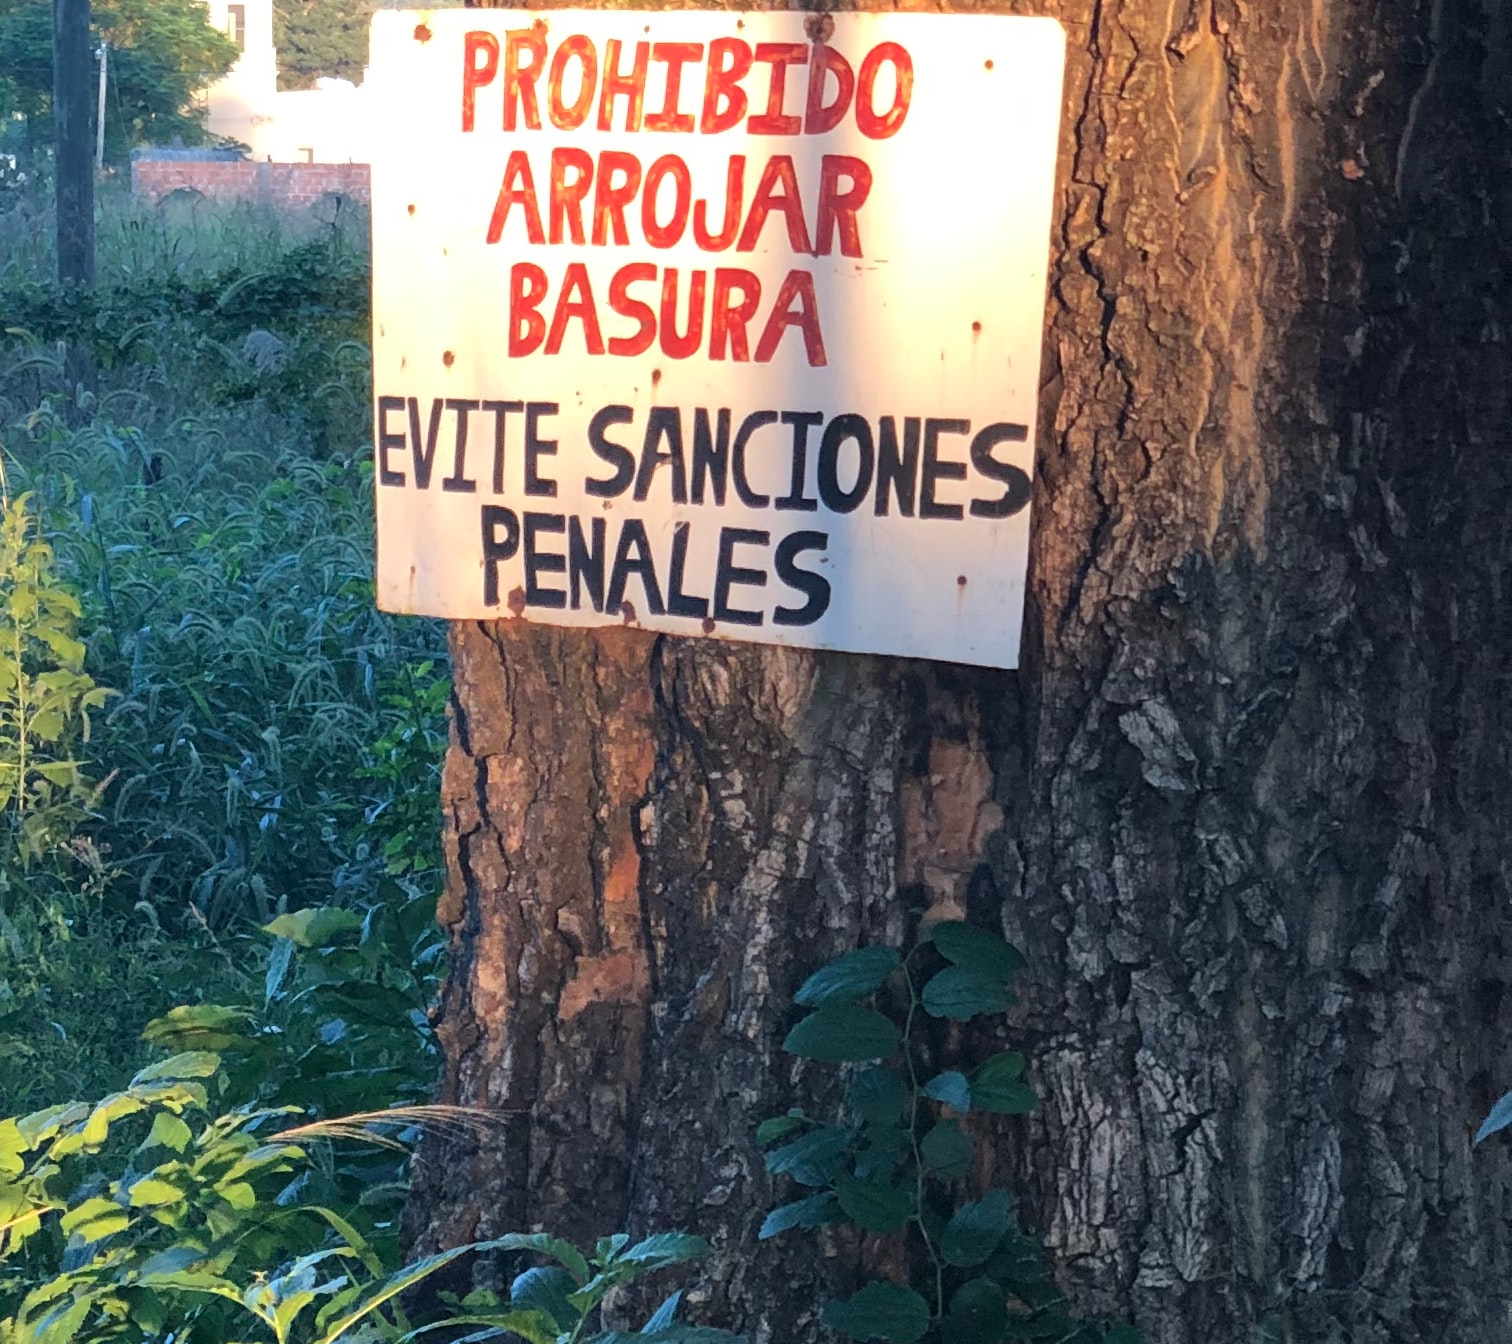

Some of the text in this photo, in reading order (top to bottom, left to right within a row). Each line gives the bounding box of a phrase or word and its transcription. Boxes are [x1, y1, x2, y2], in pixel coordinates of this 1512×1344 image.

[461, 30, 914, 140] PROHIBIDO
[487, 147, 873, 258] ARROJAR
[508, 262, 828, 367] BASURA
[377, 396, 1033, 521] EVITE SANCIONES
[481, 504, 832, 627] PENALES
